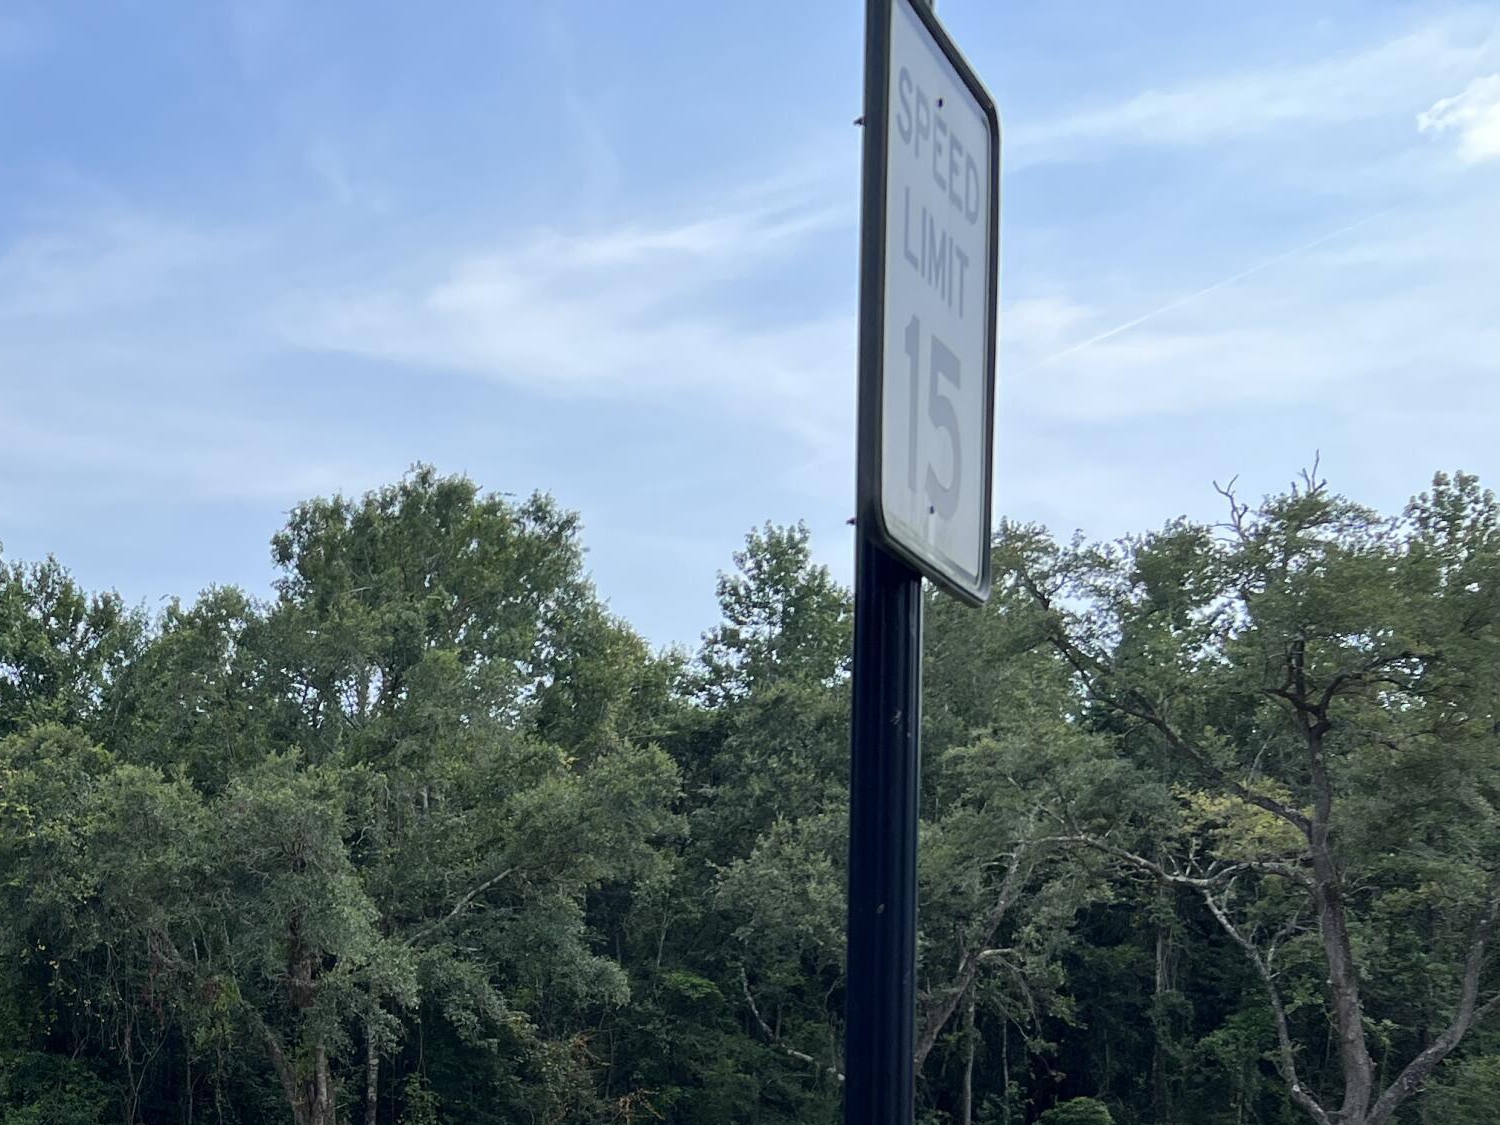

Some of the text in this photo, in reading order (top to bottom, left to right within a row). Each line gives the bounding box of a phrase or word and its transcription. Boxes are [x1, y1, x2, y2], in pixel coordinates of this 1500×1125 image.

[897, 66, 979, 226] SPEED
[903, 186, 969, 318] LIMIT
[904, 314, 962, 521] 15
